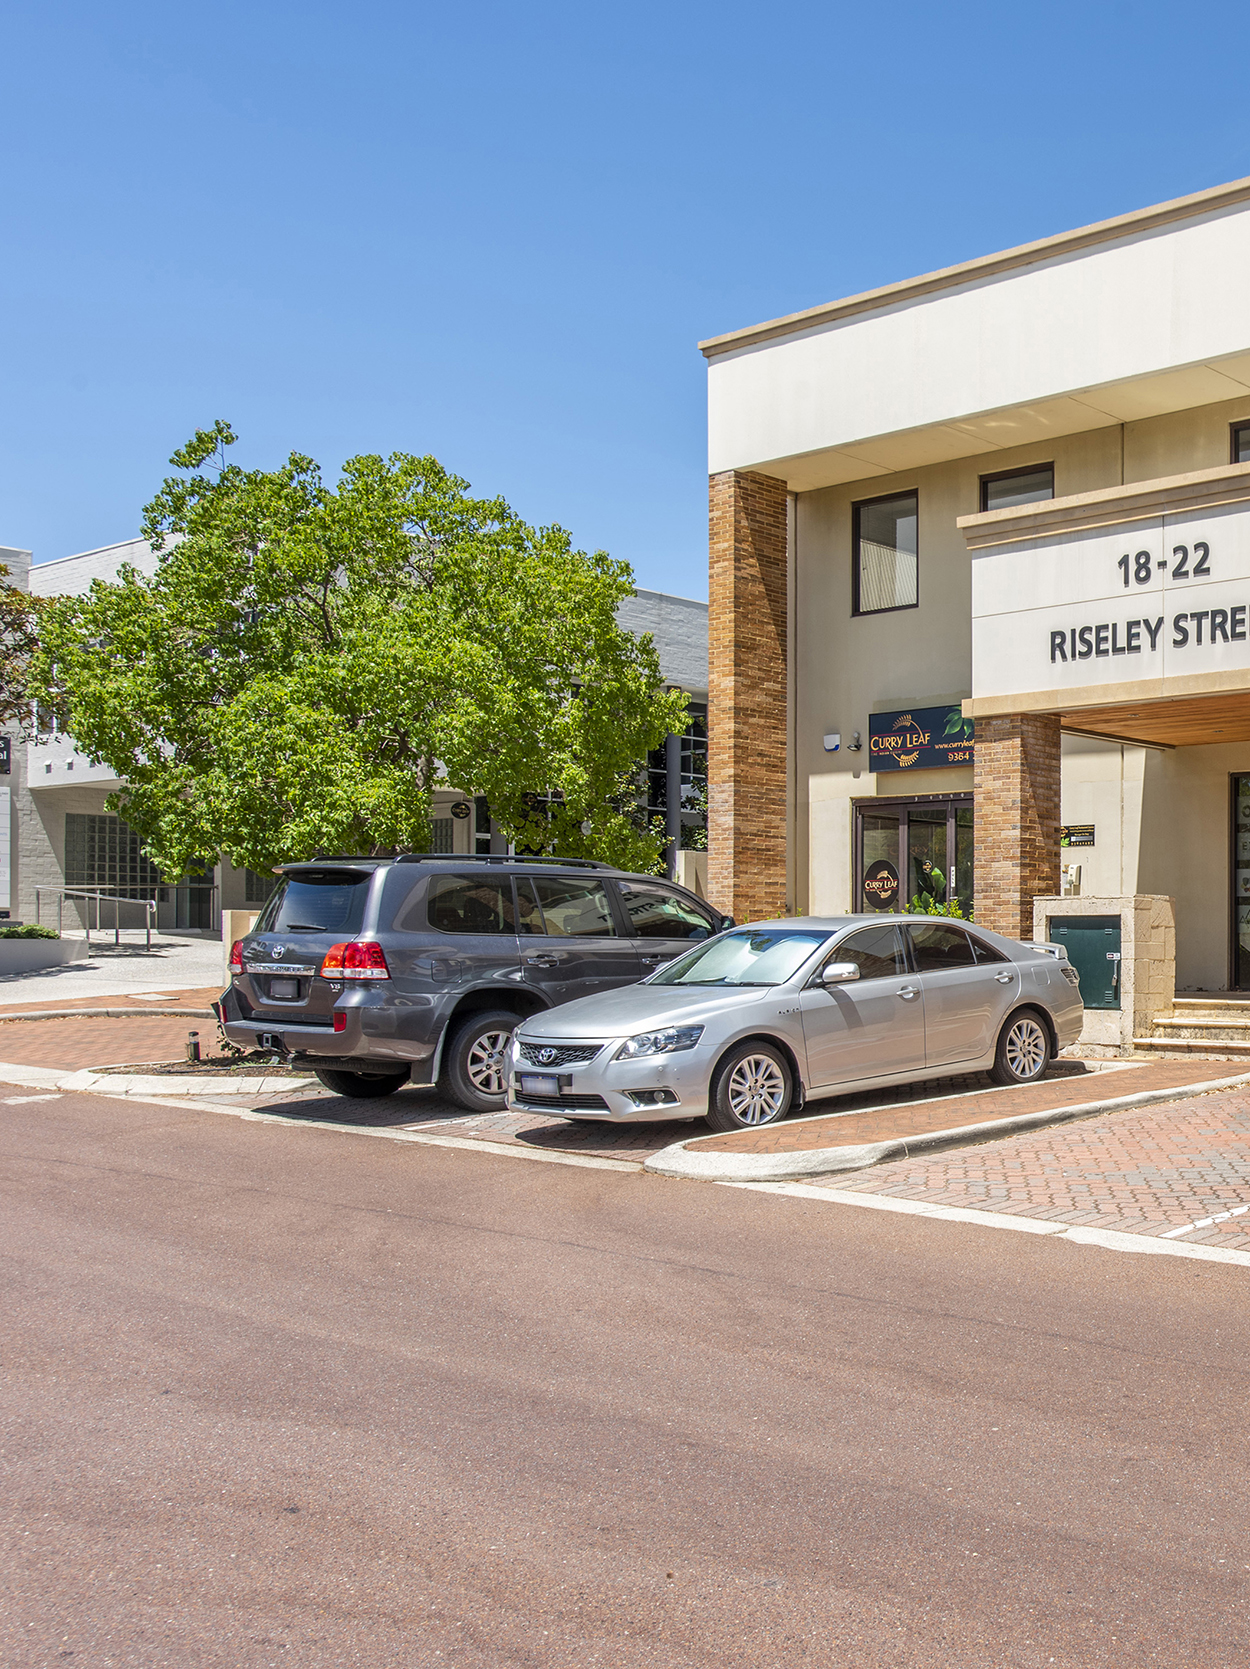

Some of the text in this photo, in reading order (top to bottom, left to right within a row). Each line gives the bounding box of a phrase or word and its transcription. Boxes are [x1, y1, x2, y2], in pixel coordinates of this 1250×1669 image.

[1117, 541, 1211, 588] 18-22
[1050, 616, 1165, 664] RISELEY
[870, 733, 931, 751] CURRY LEAF
[865, 880, 899, 890] CURRY LEAF
